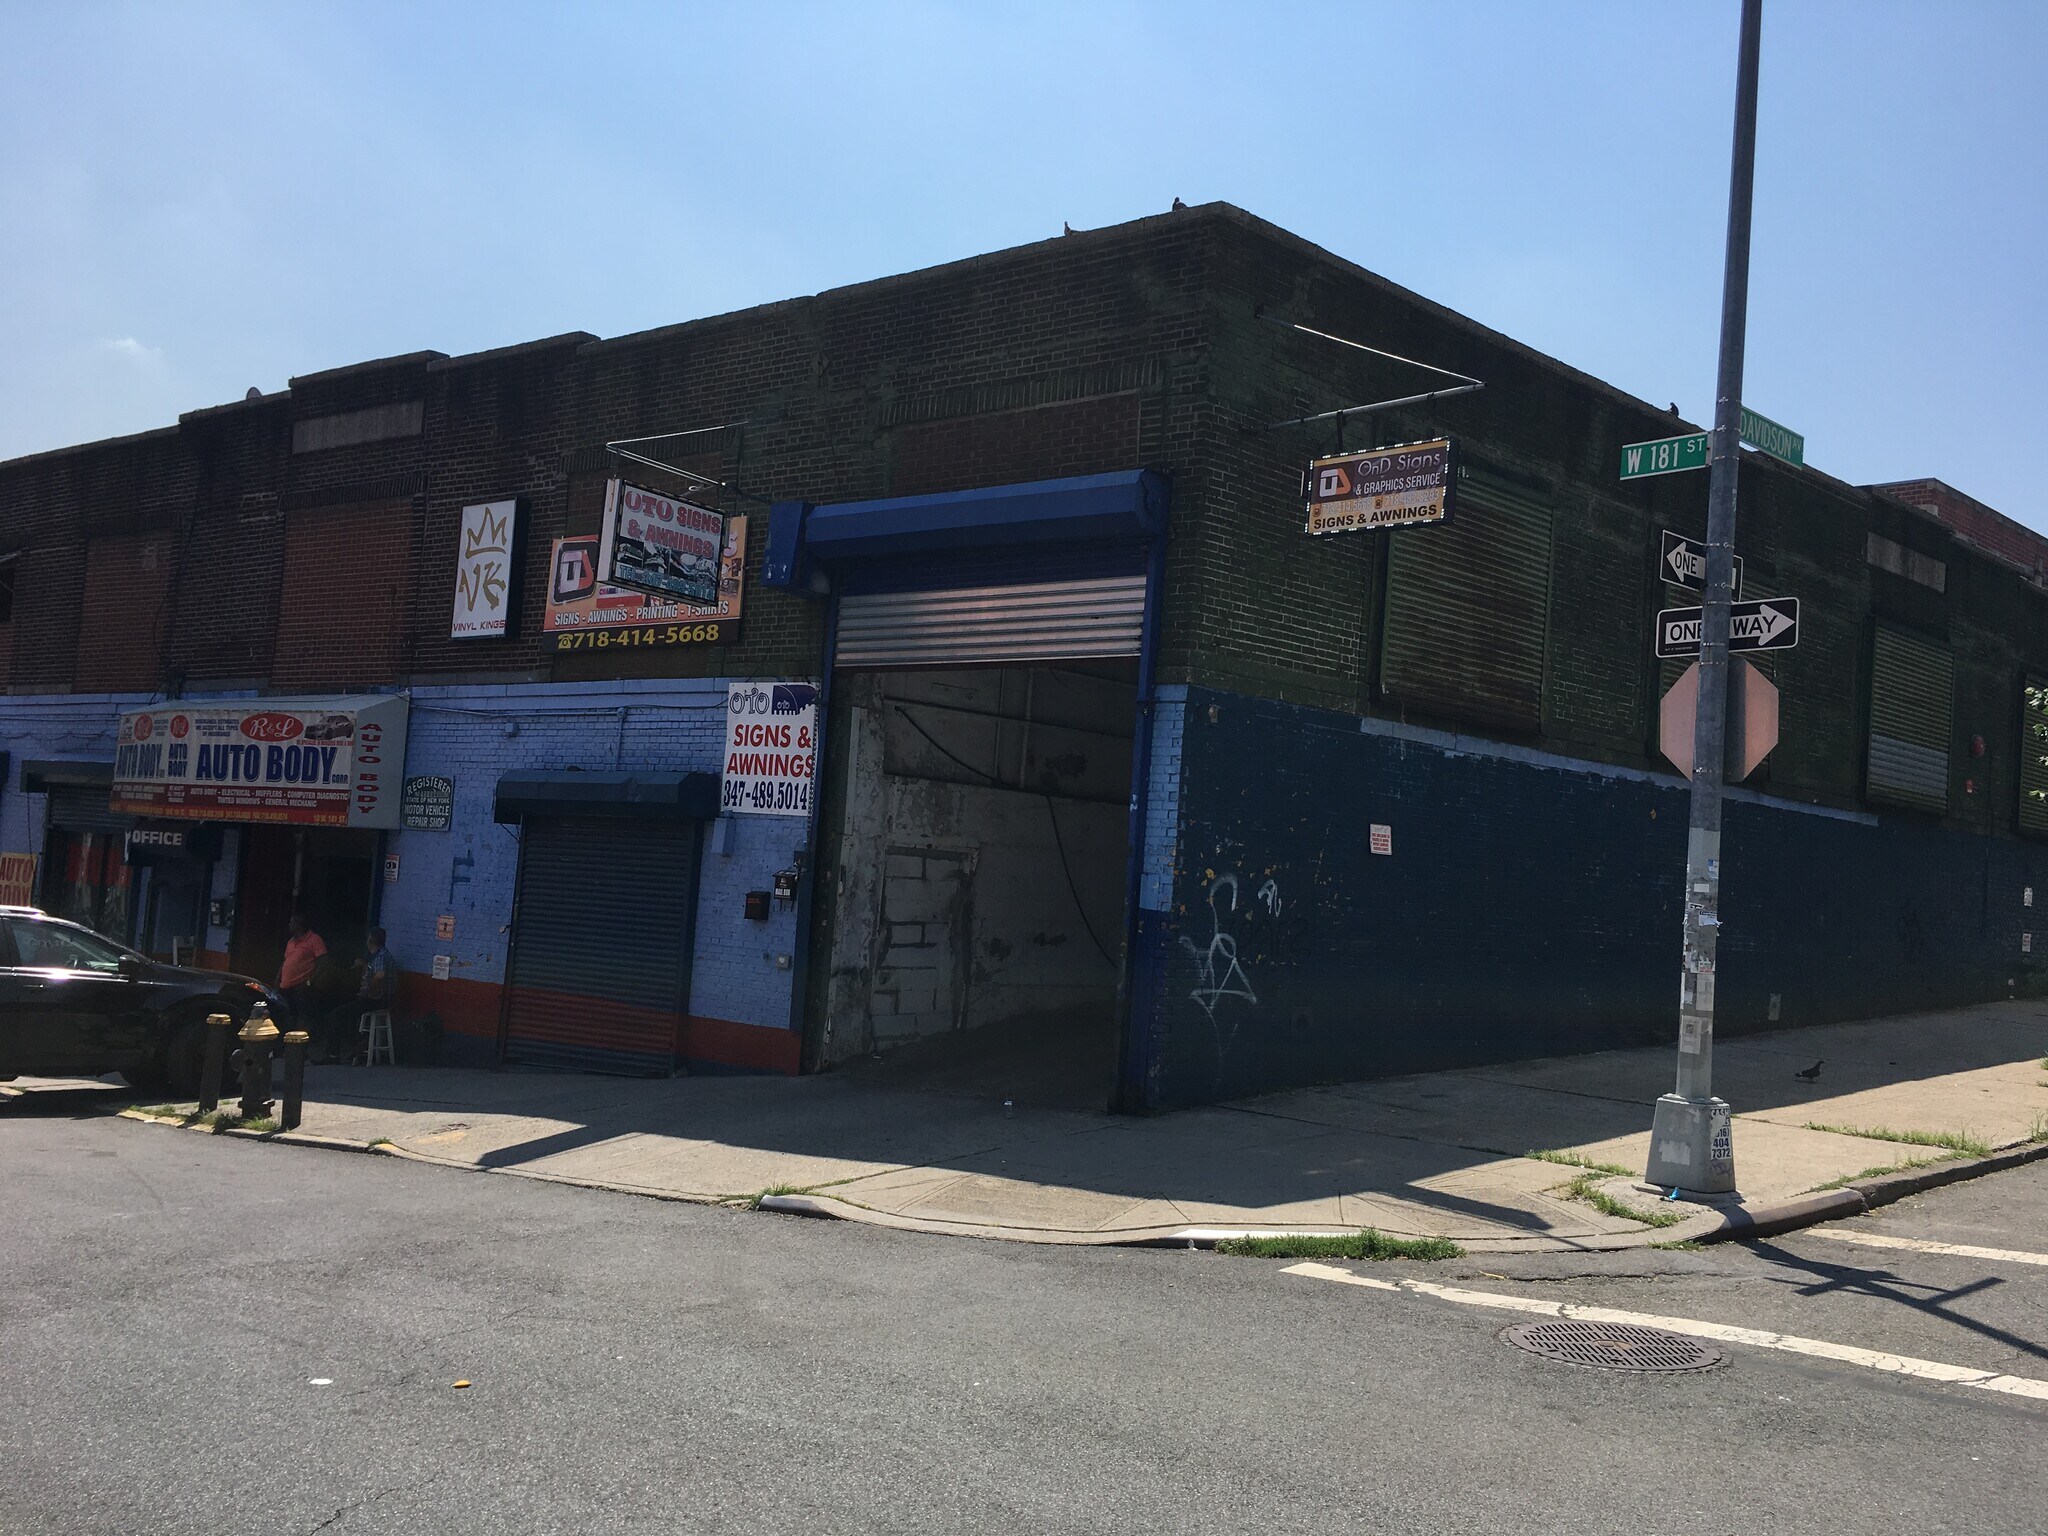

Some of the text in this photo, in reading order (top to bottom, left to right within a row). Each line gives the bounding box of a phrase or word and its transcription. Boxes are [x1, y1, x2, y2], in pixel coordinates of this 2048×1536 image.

[1740, 410, 1802, 459] DAVIDSON AV
[1396, 453, 1440, 474] Signs
[1627, 438, 1705, 474] W 181 ST
[1355, 472, 1441, 496] & GRAPHICS SERVICE
[625, 491, 722, 535] OTO SIGNS
[1313, 504, 1437, 529] SIGNS & AWNINGS
[627, 519, 641, 539] &
[644, 524, 715, 559] AWNINGS
[1675, 551, 1697, 575] ONE
[453, 620, 506, 632] VINYL KINGS
[555, 612, 580, 626] SIGNS
[587, 608, 628, 624] AWNINGS
[635, 605, 678, 621] PRINTING
[1733, 615, 1778, 636] WAY
[573, 624, 719, 648] 718-414-5668
[729, 687, 770, 714] OTO
[357, 723, 383, 764] AUTO
[733, 724, 812, 748] SIGNS &
[169, 743, 188, 760] AUTO
[168, 761, 188, 777] BODY
[196, 744, 261, 782] AUTO
[265, 745, 338, 784] BODY
[726, 753, 814, 778] AWNINGS
[255, 789, 283, 798] MUFFLERS
[287, 790, 315, 799] COMPUTER
[356, 773, 379, 814] BODY
[406, 776, 451, 796] REGISTERED
[723, 780, 807, 810] 347-489.5014
[265, 798, 288, 806] GENERAL
[289, 799, 317, 808] MECHANIC
[404, 804, 450, 816] MOTOR VEHICLE
[407, 816, 446, 828] REPAIR SHOP
[132, 830, 183, 846] OFFICE
[0, 857, 34, 883] AUTO
[1712, 1138, 1729, 1148] 404
[1715, 1127, 1730, 1138] 16)
[1711, 1147, 1731, 1158] 7372
